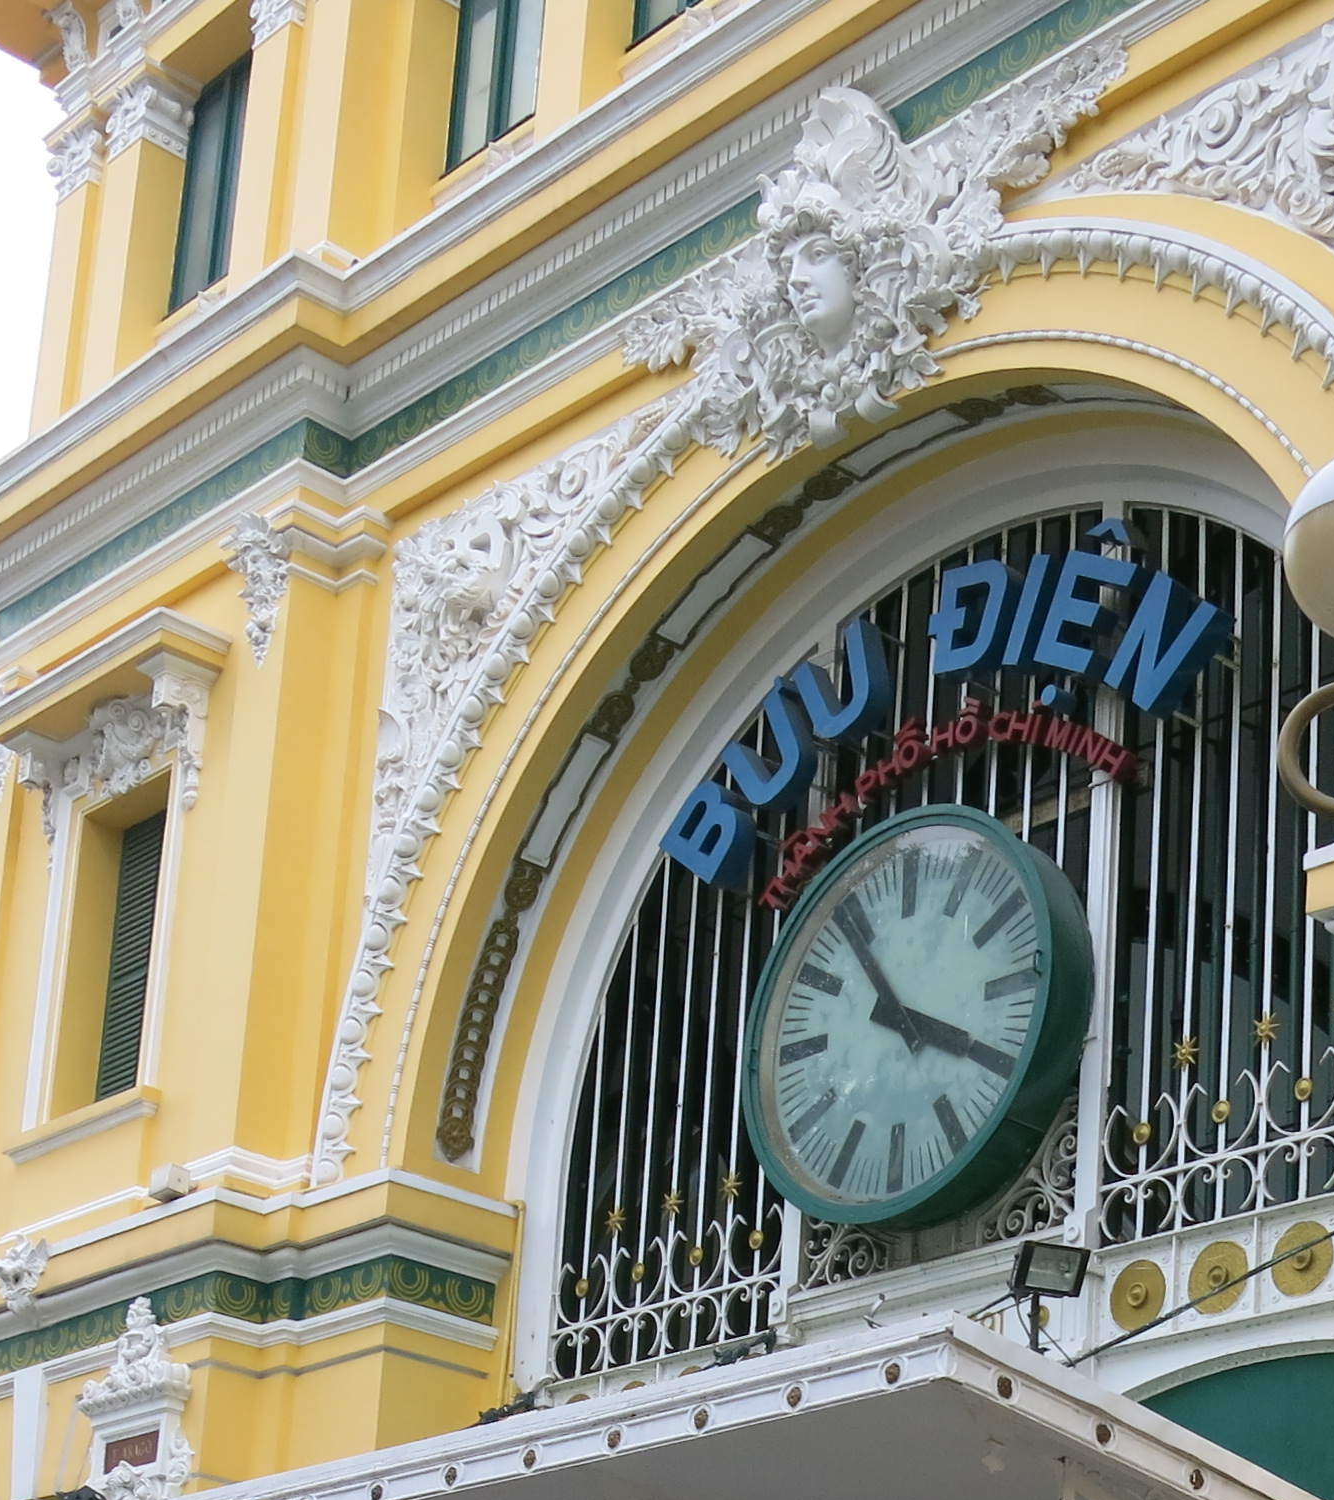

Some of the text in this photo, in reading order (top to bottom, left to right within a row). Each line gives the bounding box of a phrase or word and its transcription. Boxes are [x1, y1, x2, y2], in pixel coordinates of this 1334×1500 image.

[928, 519, 1229, 716] ĐIỆN
[854, 716, 931, 801] PHỐ
[931, 697, 985, 754] HỒ
[1044, 719, 1134, 781] MINH
